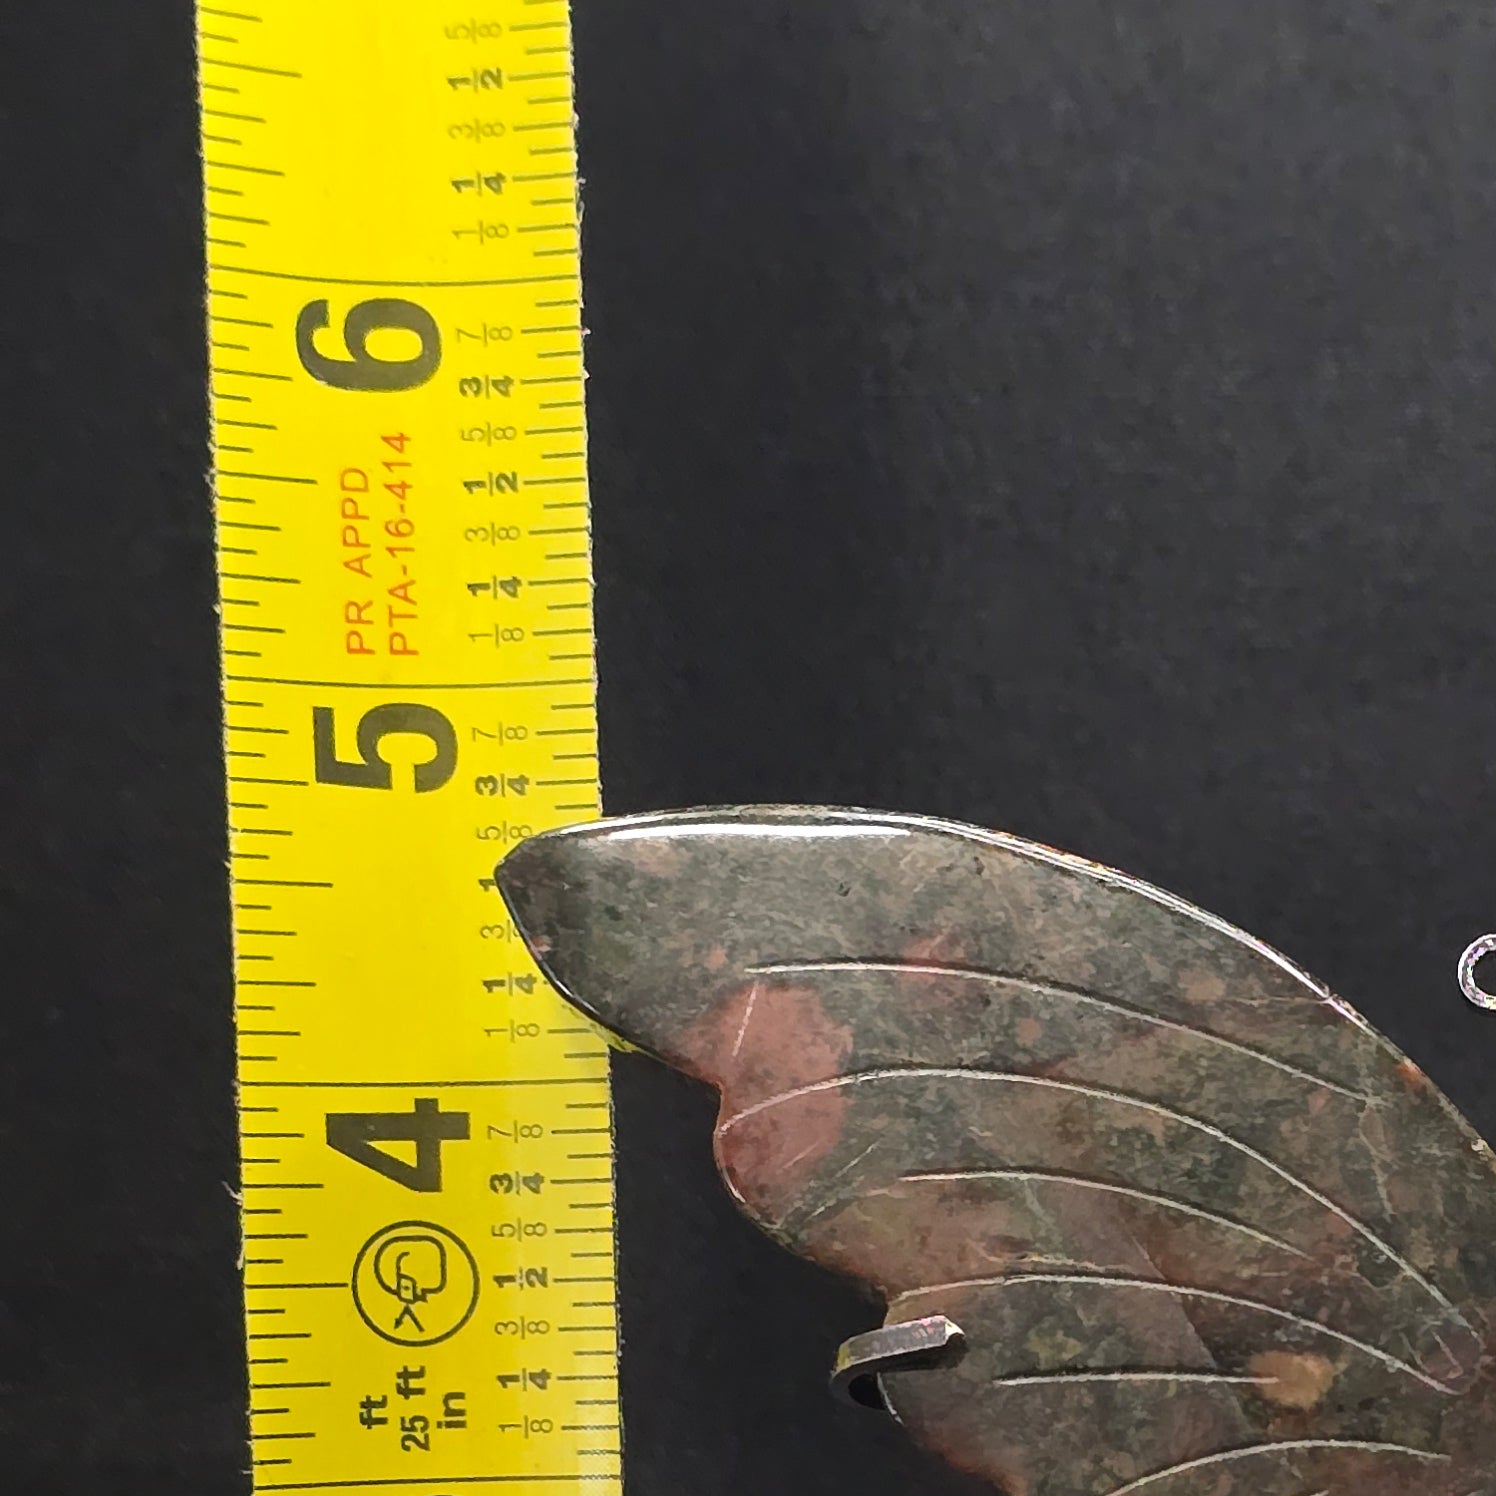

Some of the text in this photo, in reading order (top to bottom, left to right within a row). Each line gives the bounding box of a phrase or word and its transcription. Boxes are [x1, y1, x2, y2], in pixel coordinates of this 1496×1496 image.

[295, 297, 442, 393] 6
[340, 466, 375, 656] PR APPD
[381, 431, 419, 656] PTA-16-414
[312, 702, 458, 794] 5
[325, 1097, 470, 1193] 4
[359, 1394, 388, 1430] ft
[396, 1364, 431, 1452] 25 ft
[437, 1391, 467, 1430] in
